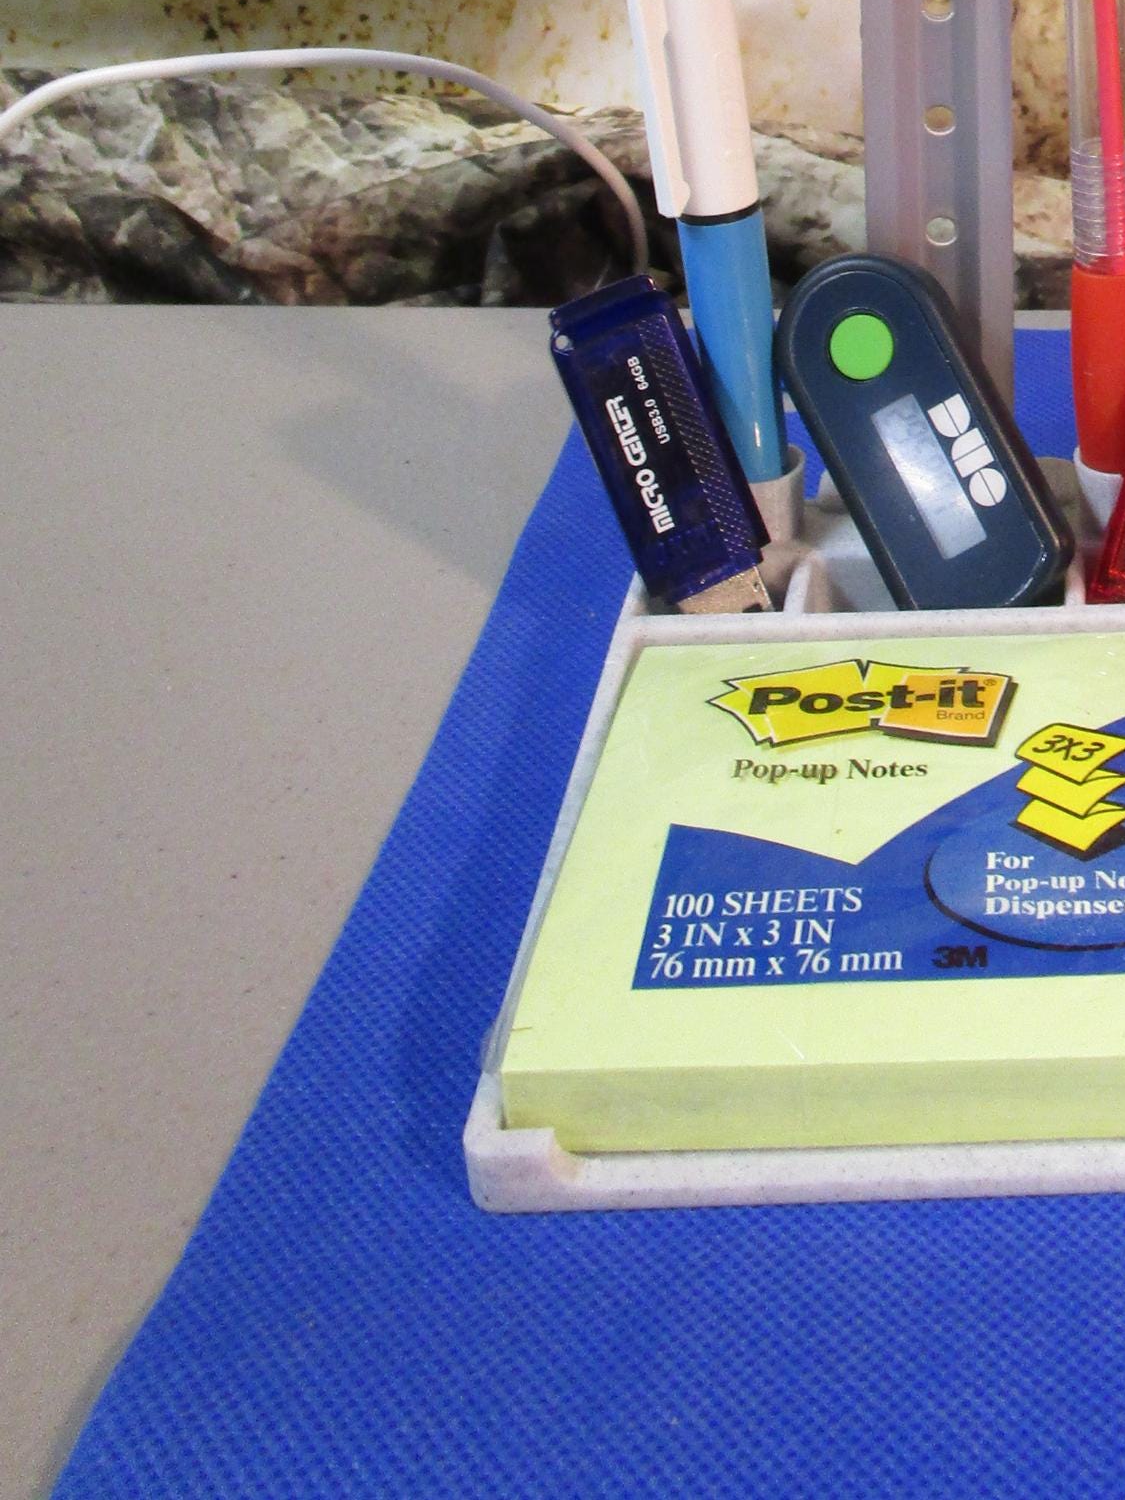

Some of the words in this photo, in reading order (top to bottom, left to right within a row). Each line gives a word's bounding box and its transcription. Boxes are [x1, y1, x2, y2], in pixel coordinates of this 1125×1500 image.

[627, 356, 649, 391] 64GB
[605, 395, 648, 467] CENTER
[644, 399, 671, 445] USB3.0
[635, 468, 676, 534] MICRO
[936, 710, 986, 721] Brand
[732, 758, 839, 784] Pop-up
[848, 758, 929, 780] Notes
[986, 851, 1035, 870] For
[985, 873, 1086, 894] Pop-up
[663, 892, 715, 919] 100
[721, 887, 864, 917] SHEETS
[652, 923, 672, 949] 3
[681, 921, 726, 948] IN
[733, 925, 754, 946] x
[761, 920, 782, 946] 3
[790, 918, 836, 945] IN
[649, 951, 684, 979] 76
[692, 954, 756, 979] mm
[766, 955, 785, 976] x
[795, 948, 831, 975] 76
[839, 950, 904, 973] mm
[932, 945, 989, 969] 3M
